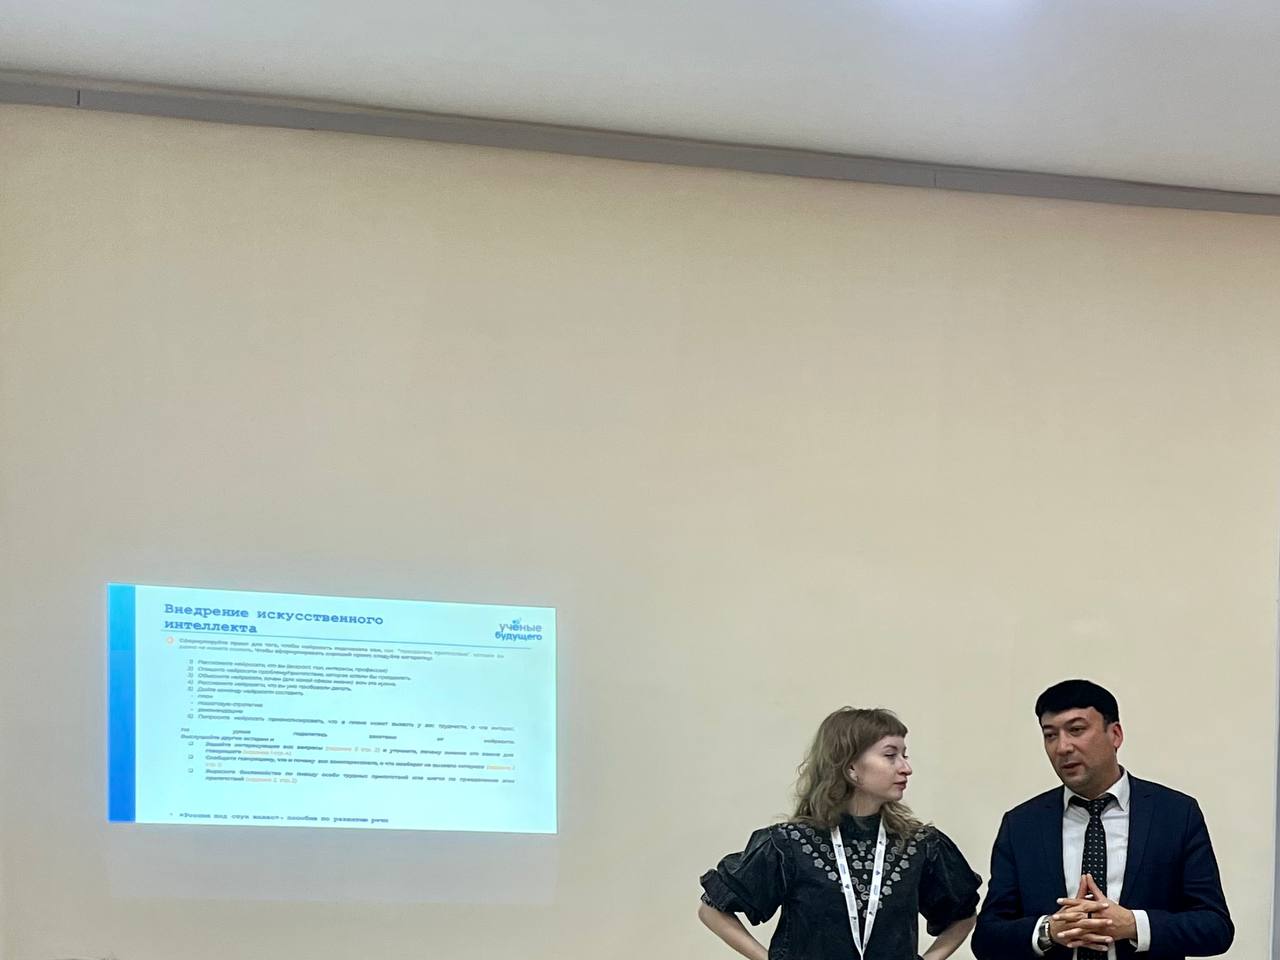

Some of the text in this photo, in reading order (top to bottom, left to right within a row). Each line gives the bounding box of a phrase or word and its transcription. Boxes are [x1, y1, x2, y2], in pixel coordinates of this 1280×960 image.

[164, 603, 384, 625] Внедрение искусственного
[164, 619, 257, 633] интеллекта
[495, 630, 543, 641] будущего
